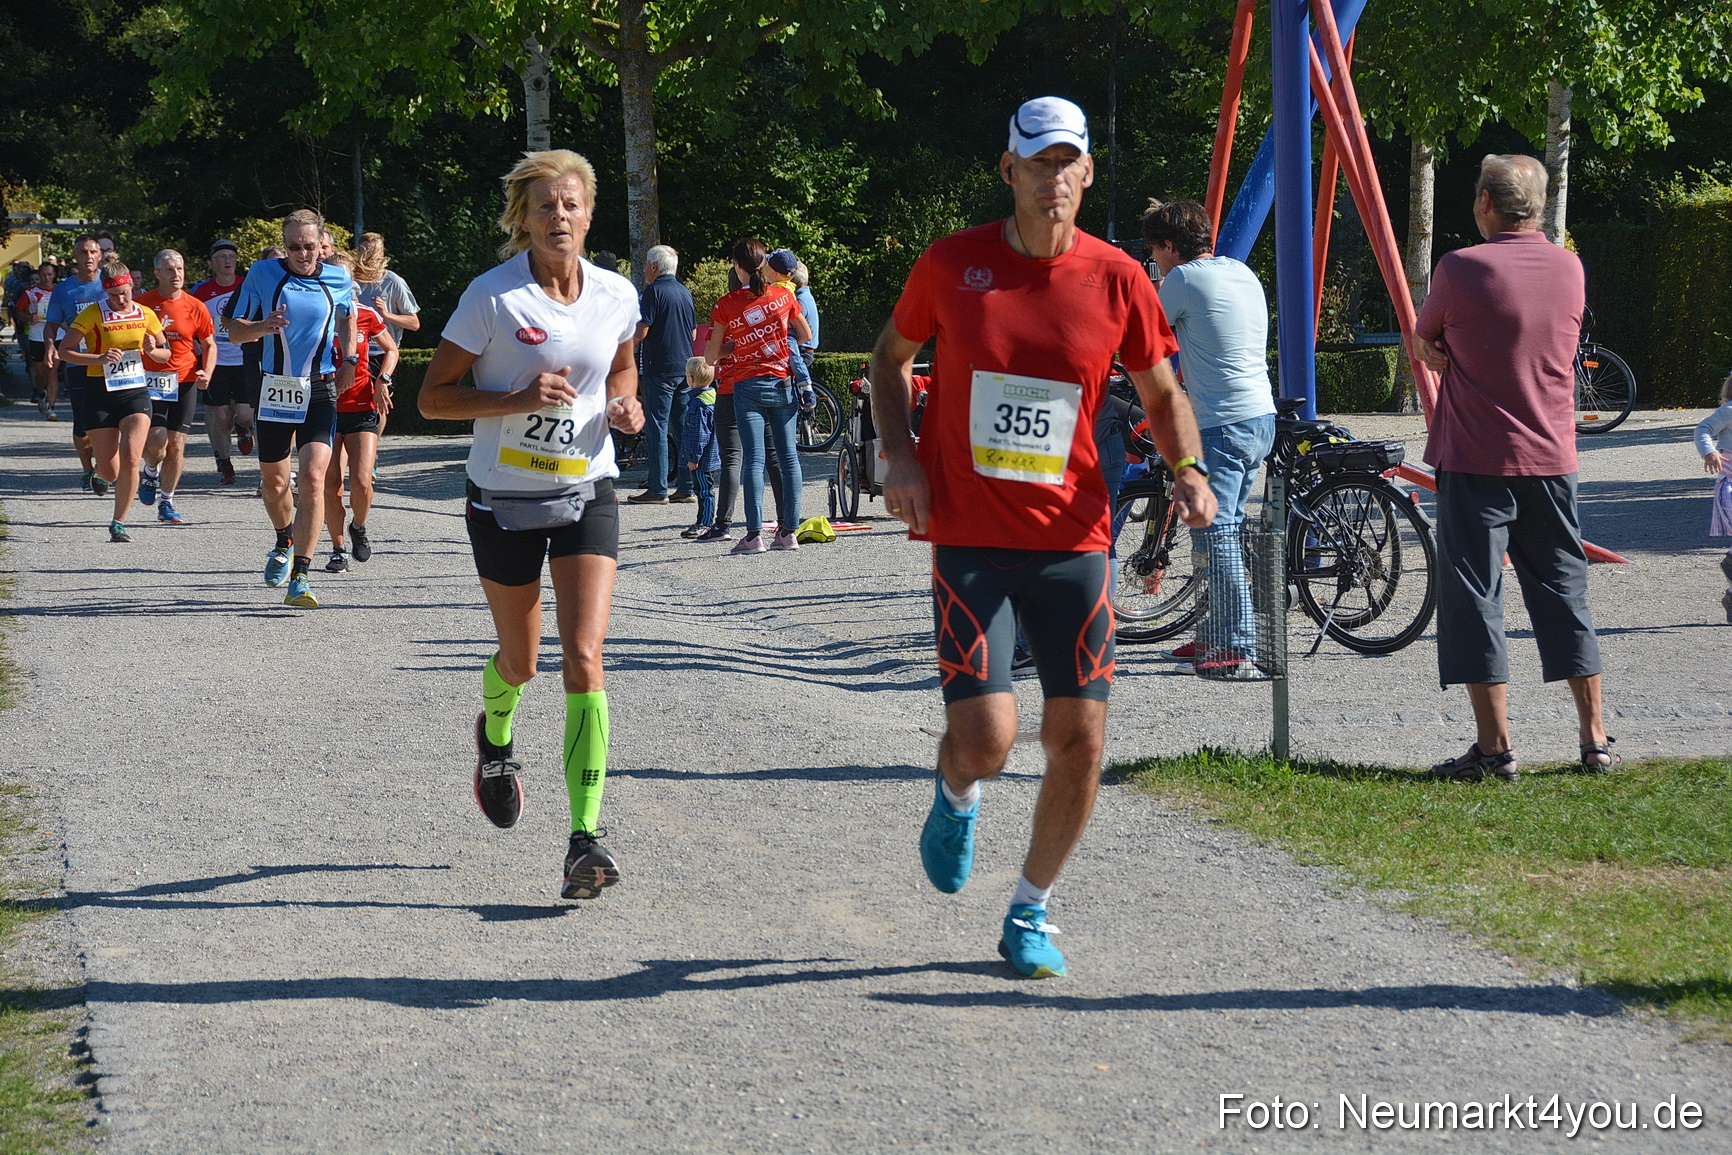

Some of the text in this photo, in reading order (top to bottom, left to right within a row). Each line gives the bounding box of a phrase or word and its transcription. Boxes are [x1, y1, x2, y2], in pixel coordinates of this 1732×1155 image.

[104, 325, 123, 333] MAX
[735, 320, 780, 347] aumbox
[109, 360, 137, 375] 2417
[146, 377, 171, 388] 2191
[267, 387, 304, 405] 2116
[1004, 384, 1050, 400] BOCK
[272, 410, 296, 419] Thomas
[994, 403, 1051, 438] 355
[524, 413, 575, 445] 273
[519, 441, 539, 451] PARTL
[988, 437, 1010, 446] PARTL
[530, 457, 560, 471] Heidi
